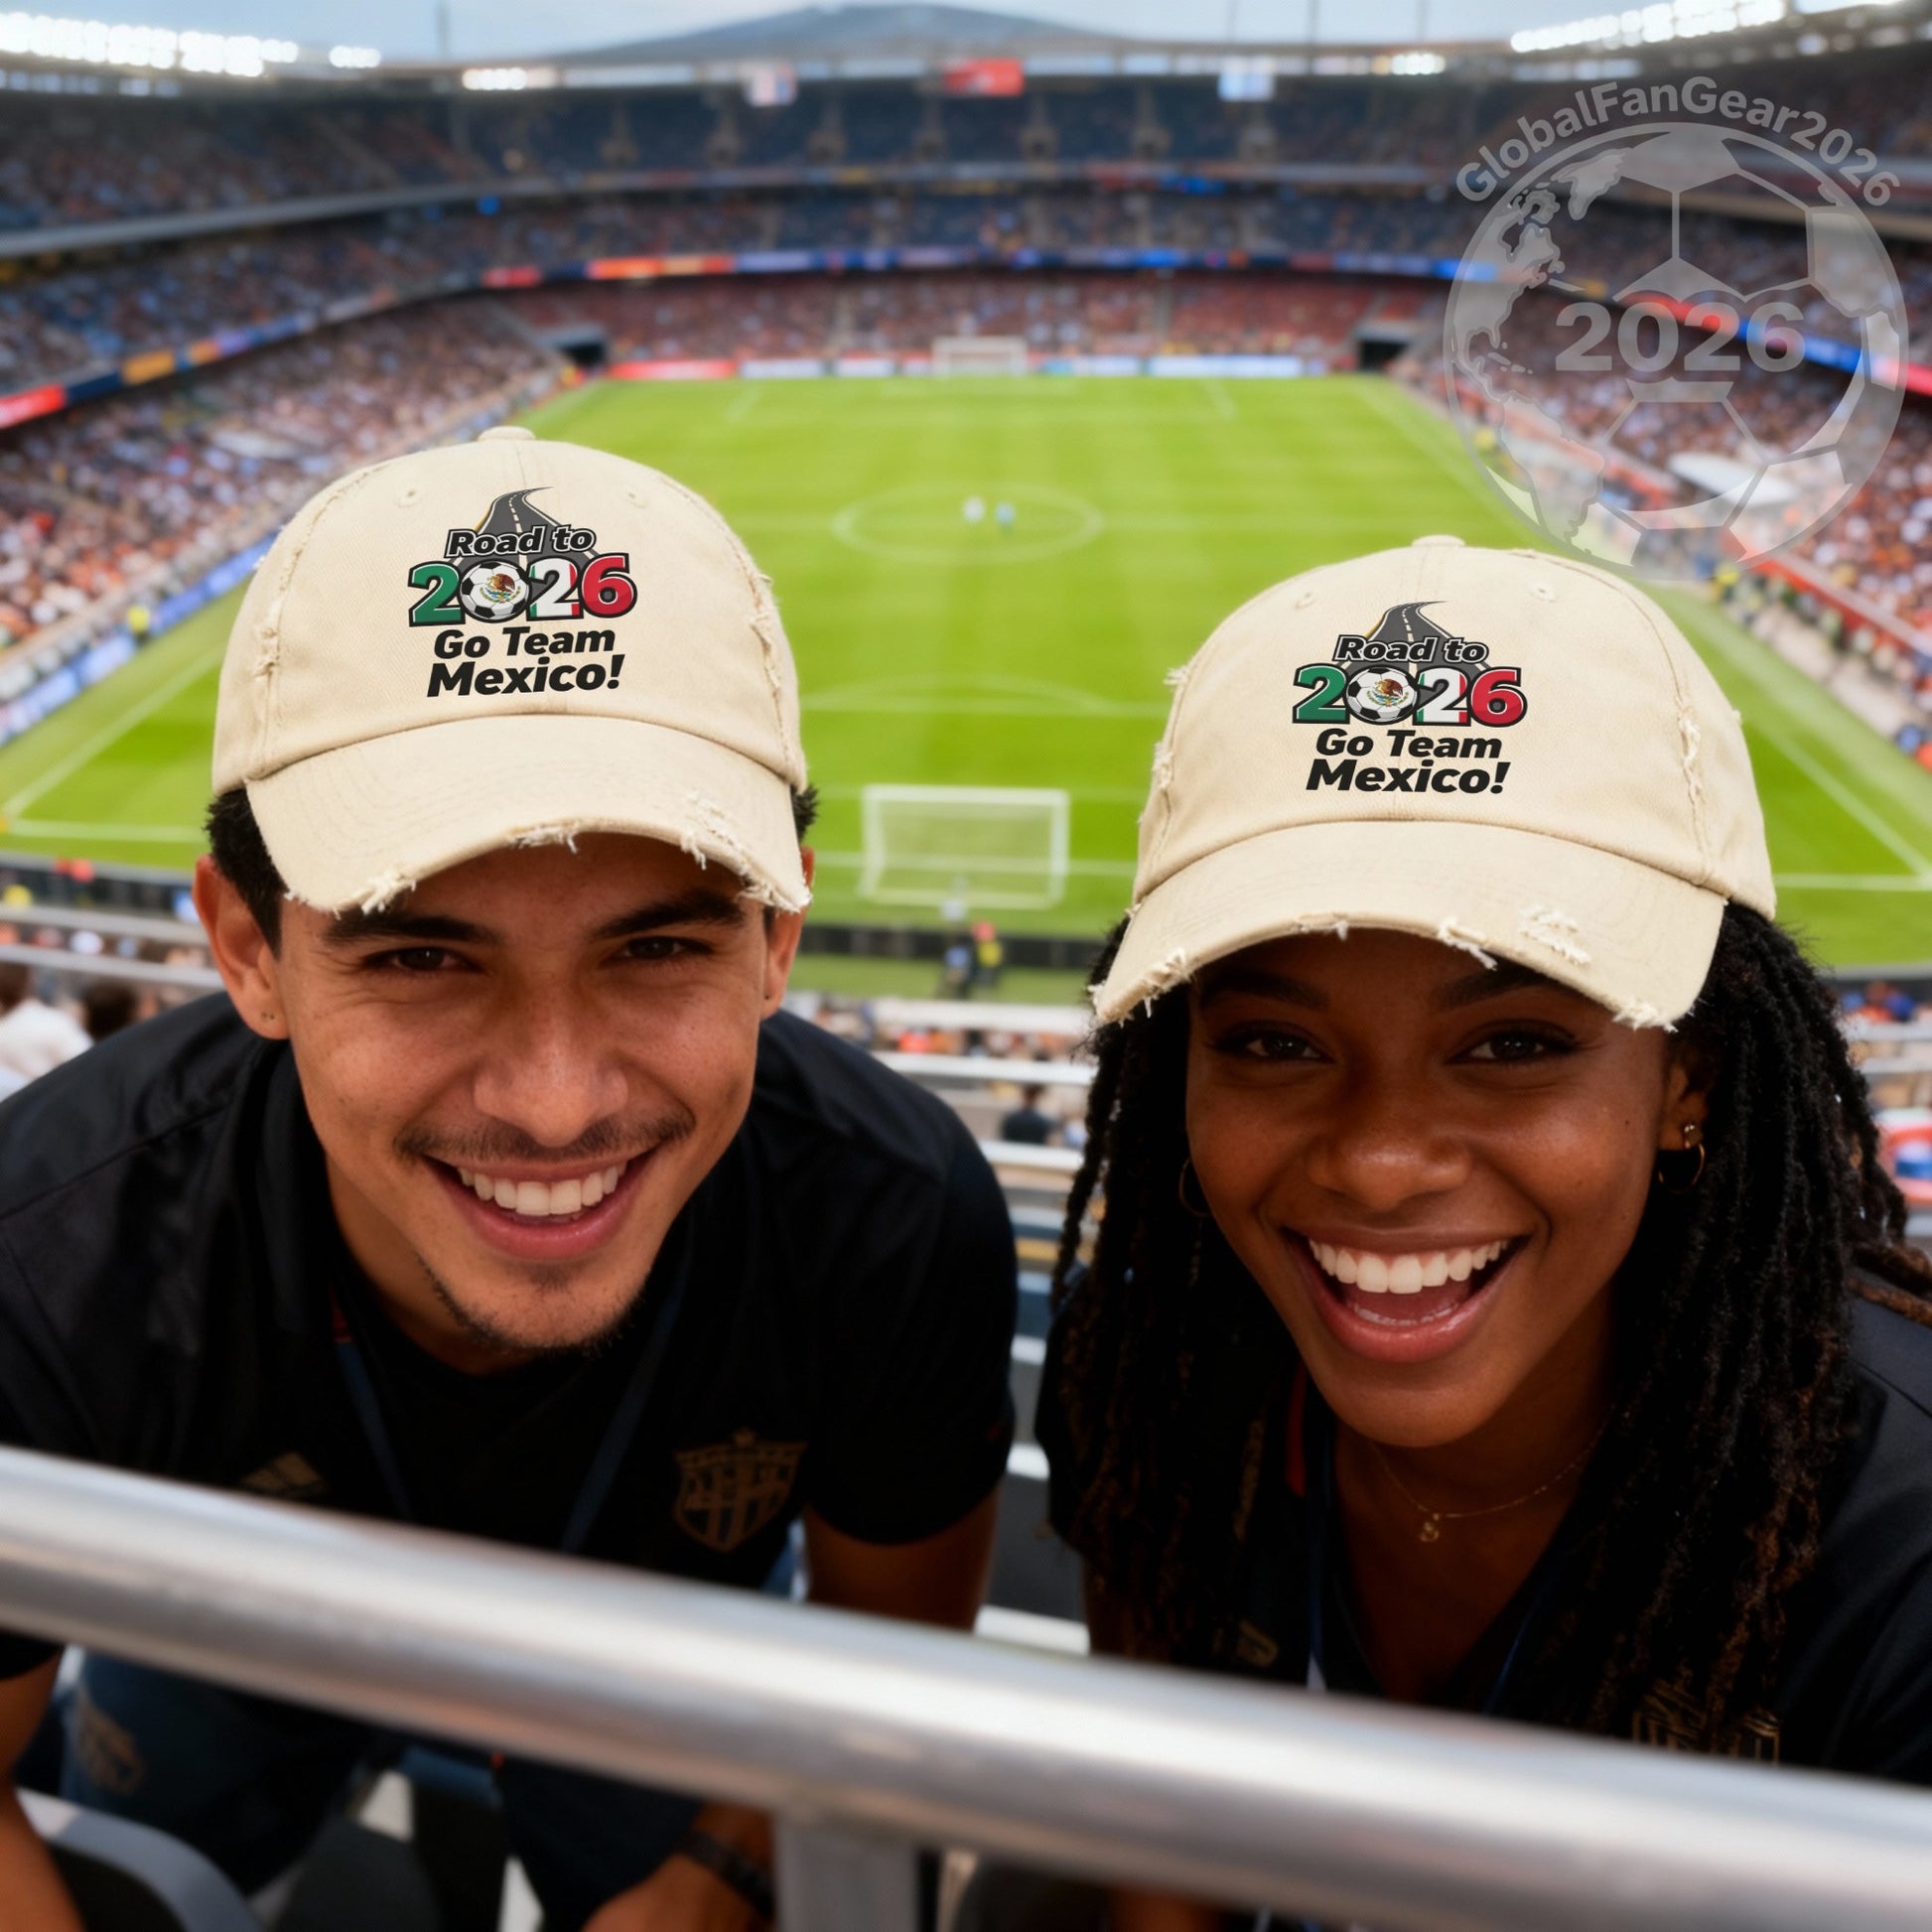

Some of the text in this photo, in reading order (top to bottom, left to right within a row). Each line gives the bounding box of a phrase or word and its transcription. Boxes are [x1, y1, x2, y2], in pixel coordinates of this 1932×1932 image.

[444, 524, 597, 558] Road to
[407, 552, 637, 627] 2026
[434, 625, 616, 659] Go Team
[1332, 634, 1489, 664] Road to
[426, 653, 625, 698] Mexico!
[1292, 662, 1528, 728] 2026
[1315, 728, 1503, 759] Go Team
[1306, 759, 1512, 794] Mexico!
